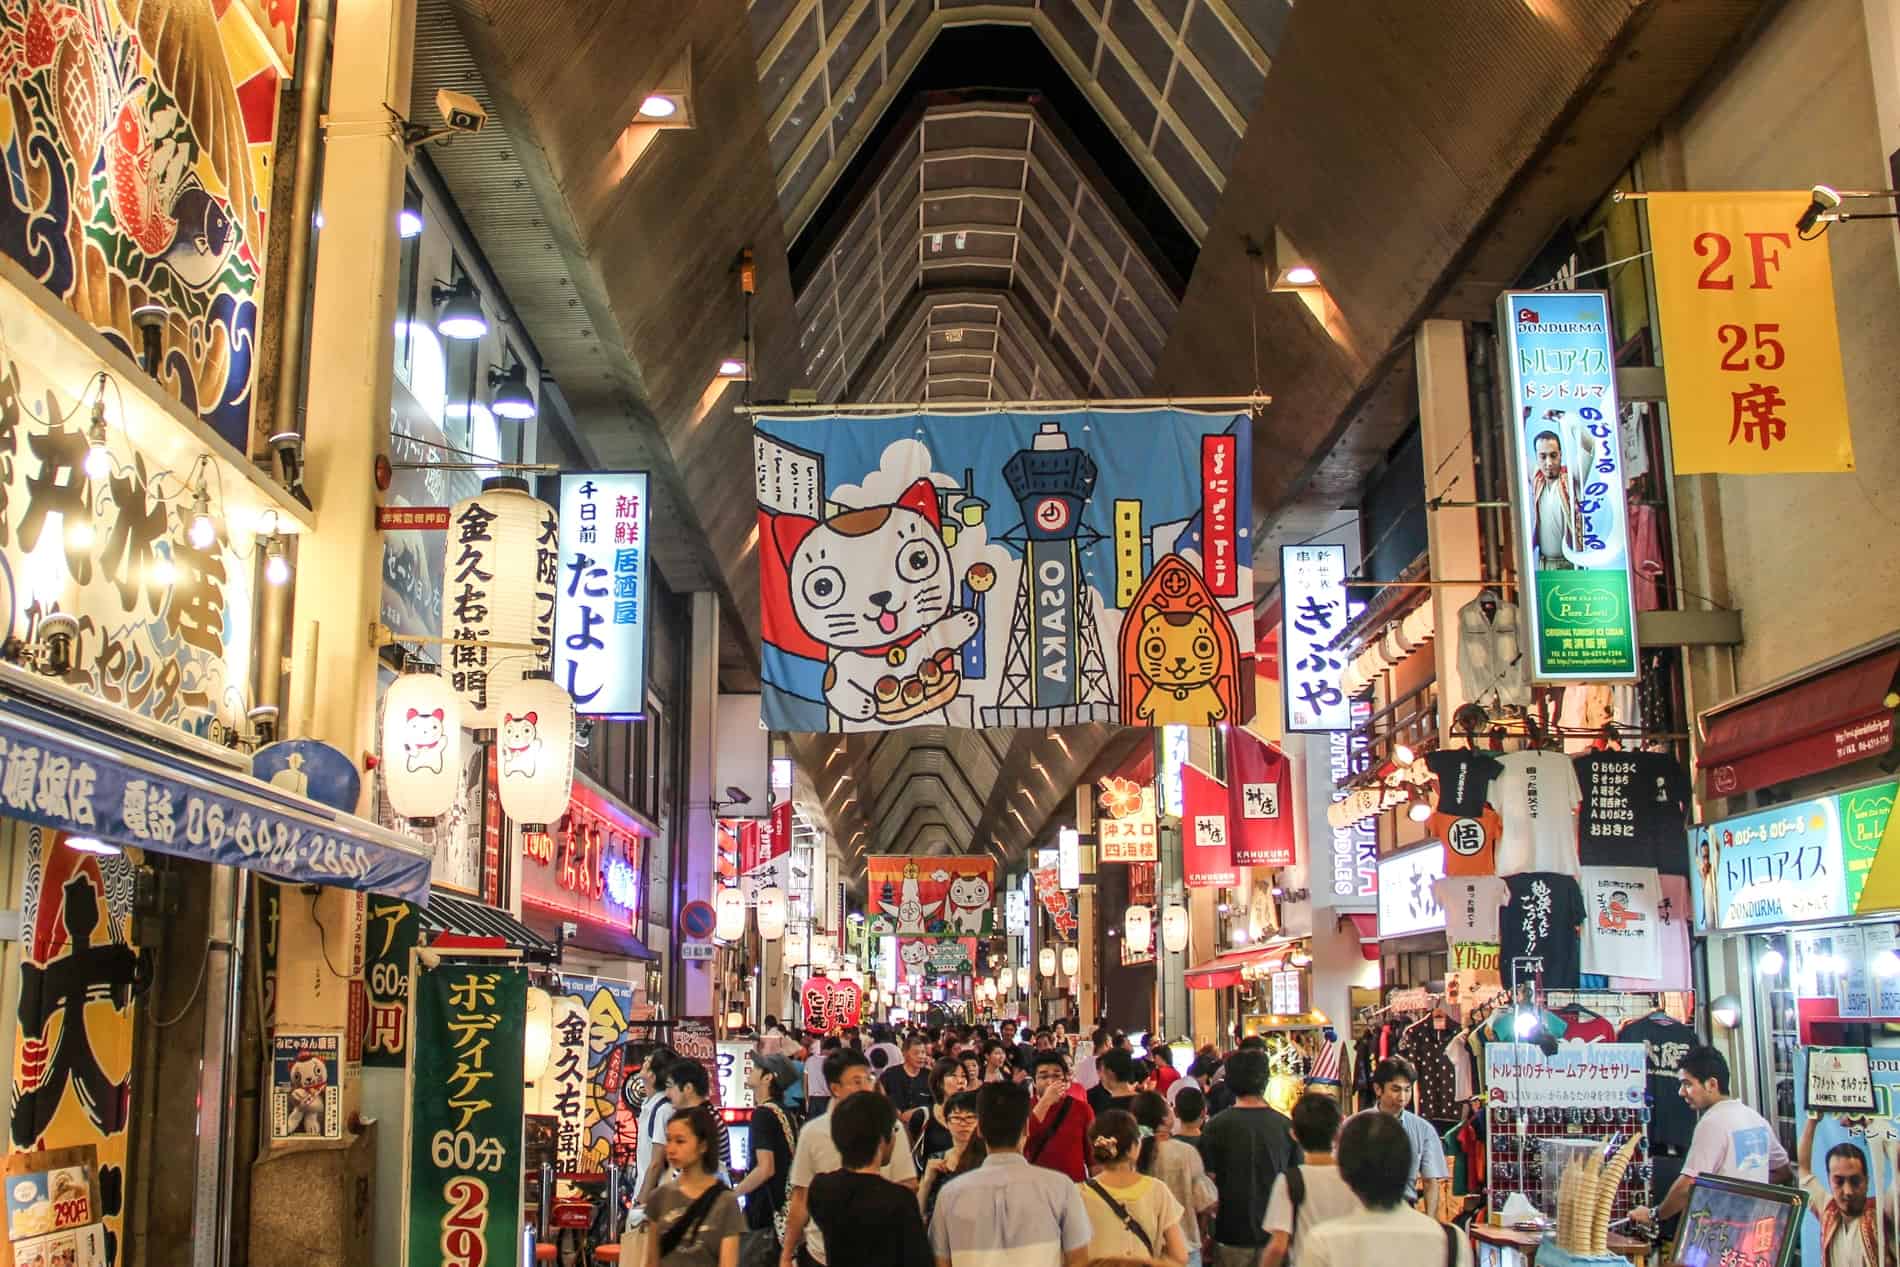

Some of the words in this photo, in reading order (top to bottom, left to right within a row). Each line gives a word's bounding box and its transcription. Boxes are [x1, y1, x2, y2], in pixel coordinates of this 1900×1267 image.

[1693, 232, 1792, 291] 2F
[1519, 322, 1602, 334] DONDURMA
[1717, 323, 1786, 372] 25
[1520, 348, 1607, 374] トルコアイス
[1526, 382, 1604, 399] ドンドルマ
[1728, 383, 1787, 451] 席
[578, 481, 598, 544] 千日前
[612, 495, 640, 625] 新鮮居酒屋
[565, 552, 609, 704] たよし
[123, 780, 176, 844] 電話
[1590, 823, 1635, 837] おおきに
[1453, 822, 1479, 850] 悟
[1726, 845, 1827, 892] トルコアイス
[446, 972, 503, 1131] ボディケア
[1490, 1063, 1641, 1080] トルコのチャームアクセサリー
[431, 1131, 505, 1173] 60分
[54, 1195, 89, 1227] 290円
